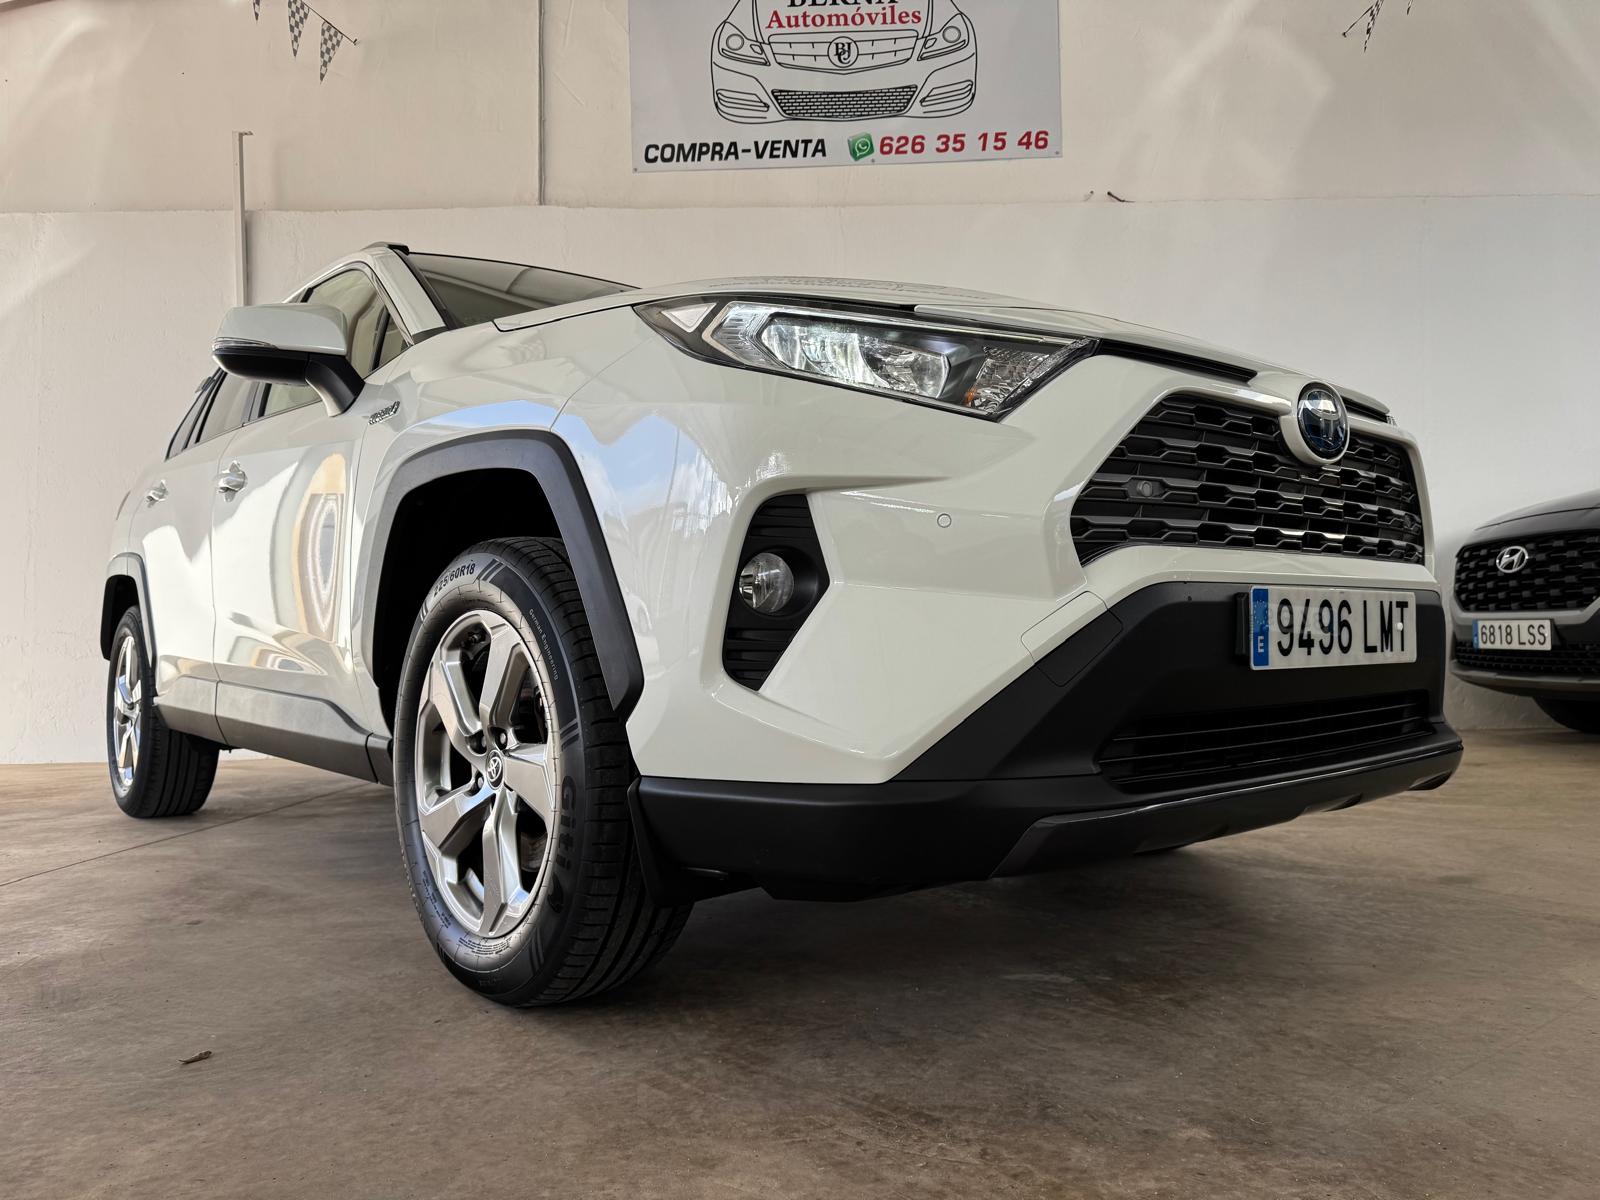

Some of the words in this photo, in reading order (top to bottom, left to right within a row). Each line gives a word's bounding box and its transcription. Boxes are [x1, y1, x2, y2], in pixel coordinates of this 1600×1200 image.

[766, 4, 922, 29] Automóviles
[644, 138, 828, 164] COMPRA-VENTA
[879, 135, 926, 155] 626
[935, 133, 966, 153] 35
[977, 131, 1008, 151] 15
[1017, 130, 1049, 150] 46
[1277, 598, 1353, 656] 9496
[1363, 600, 1409, 653] LMT
[1480, 624, 1513, 645] 6818
[1517, 624, 1547, 646] LSS
[1257, 635, 1265, 653] E
